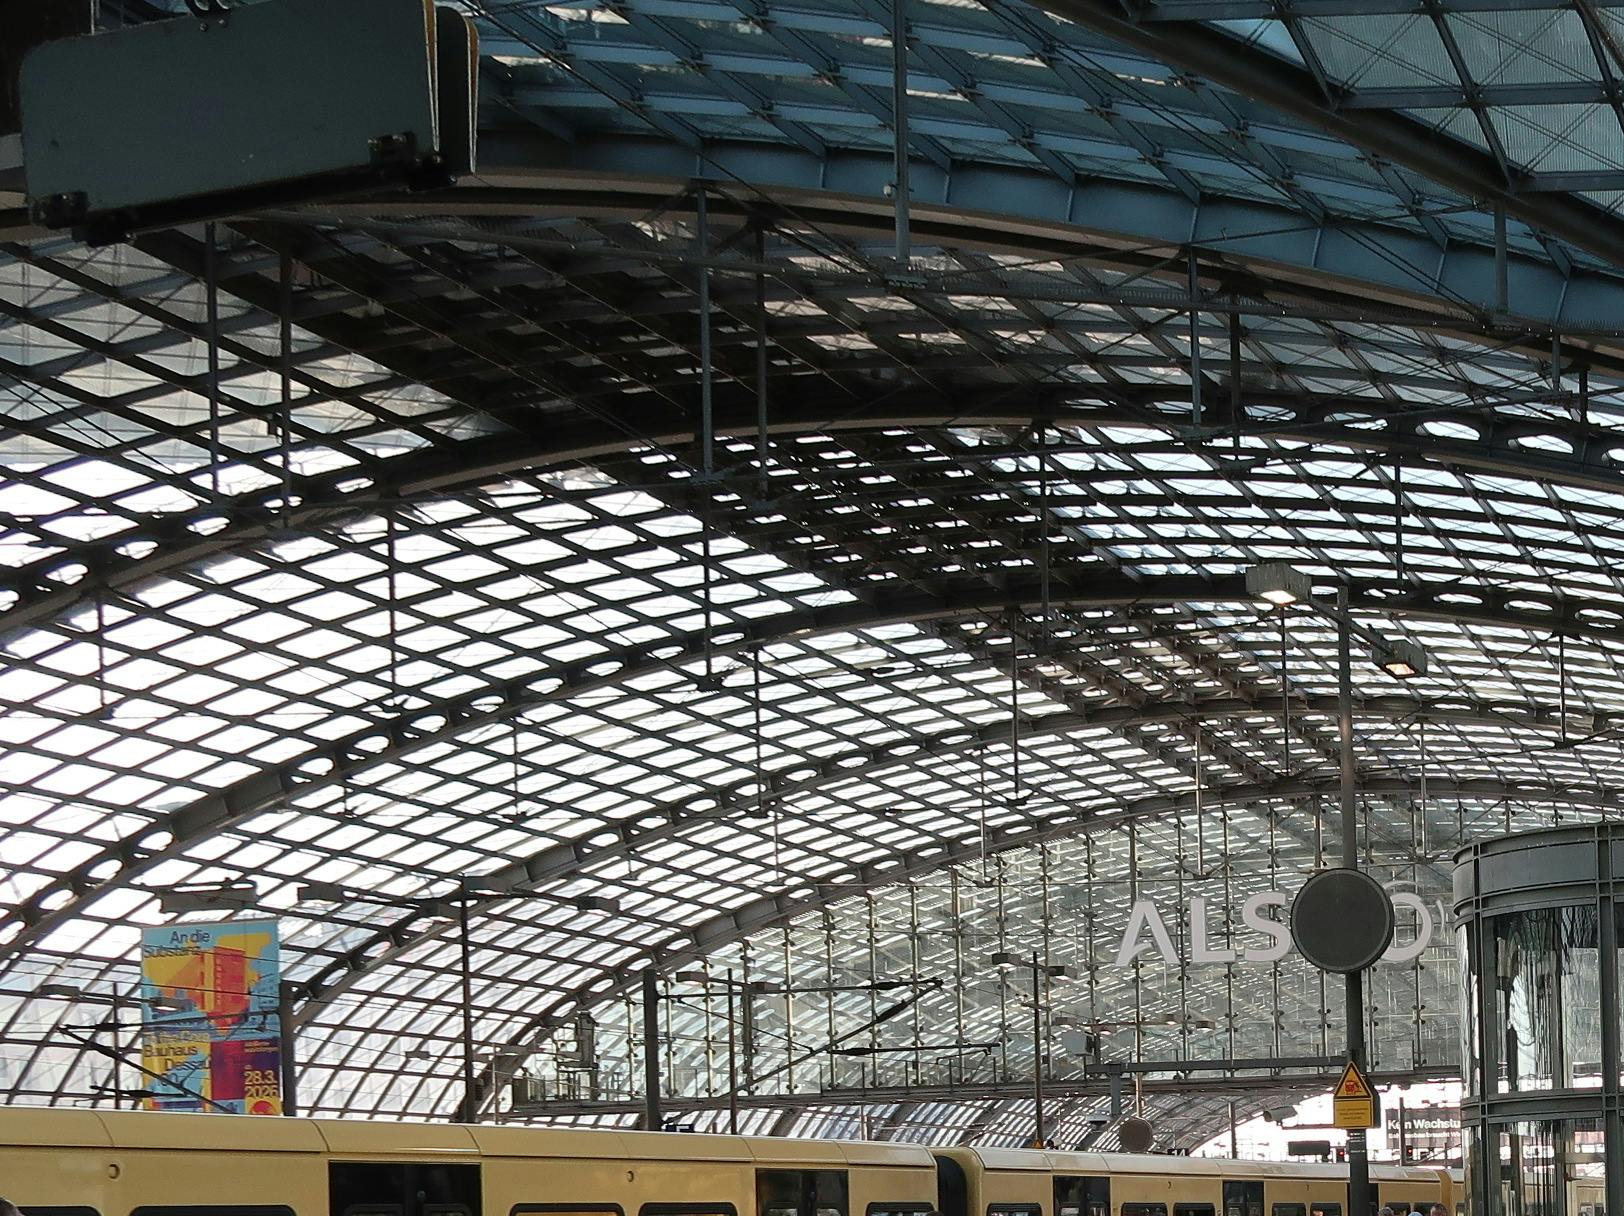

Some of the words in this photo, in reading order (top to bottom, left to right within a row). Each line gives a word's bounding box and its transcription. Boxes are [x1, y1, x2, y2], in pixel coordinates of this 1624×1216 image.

[170, 930, 189, 944] An
[190, 929, 211, 943] die
[143, 1044, 198, 1058] Bauhaus
[244, 1070, 278, 1085] 28.3.
[244, 1085, 279, 1098] 2026
[1387, 1119, 1412, 1130] Ken
